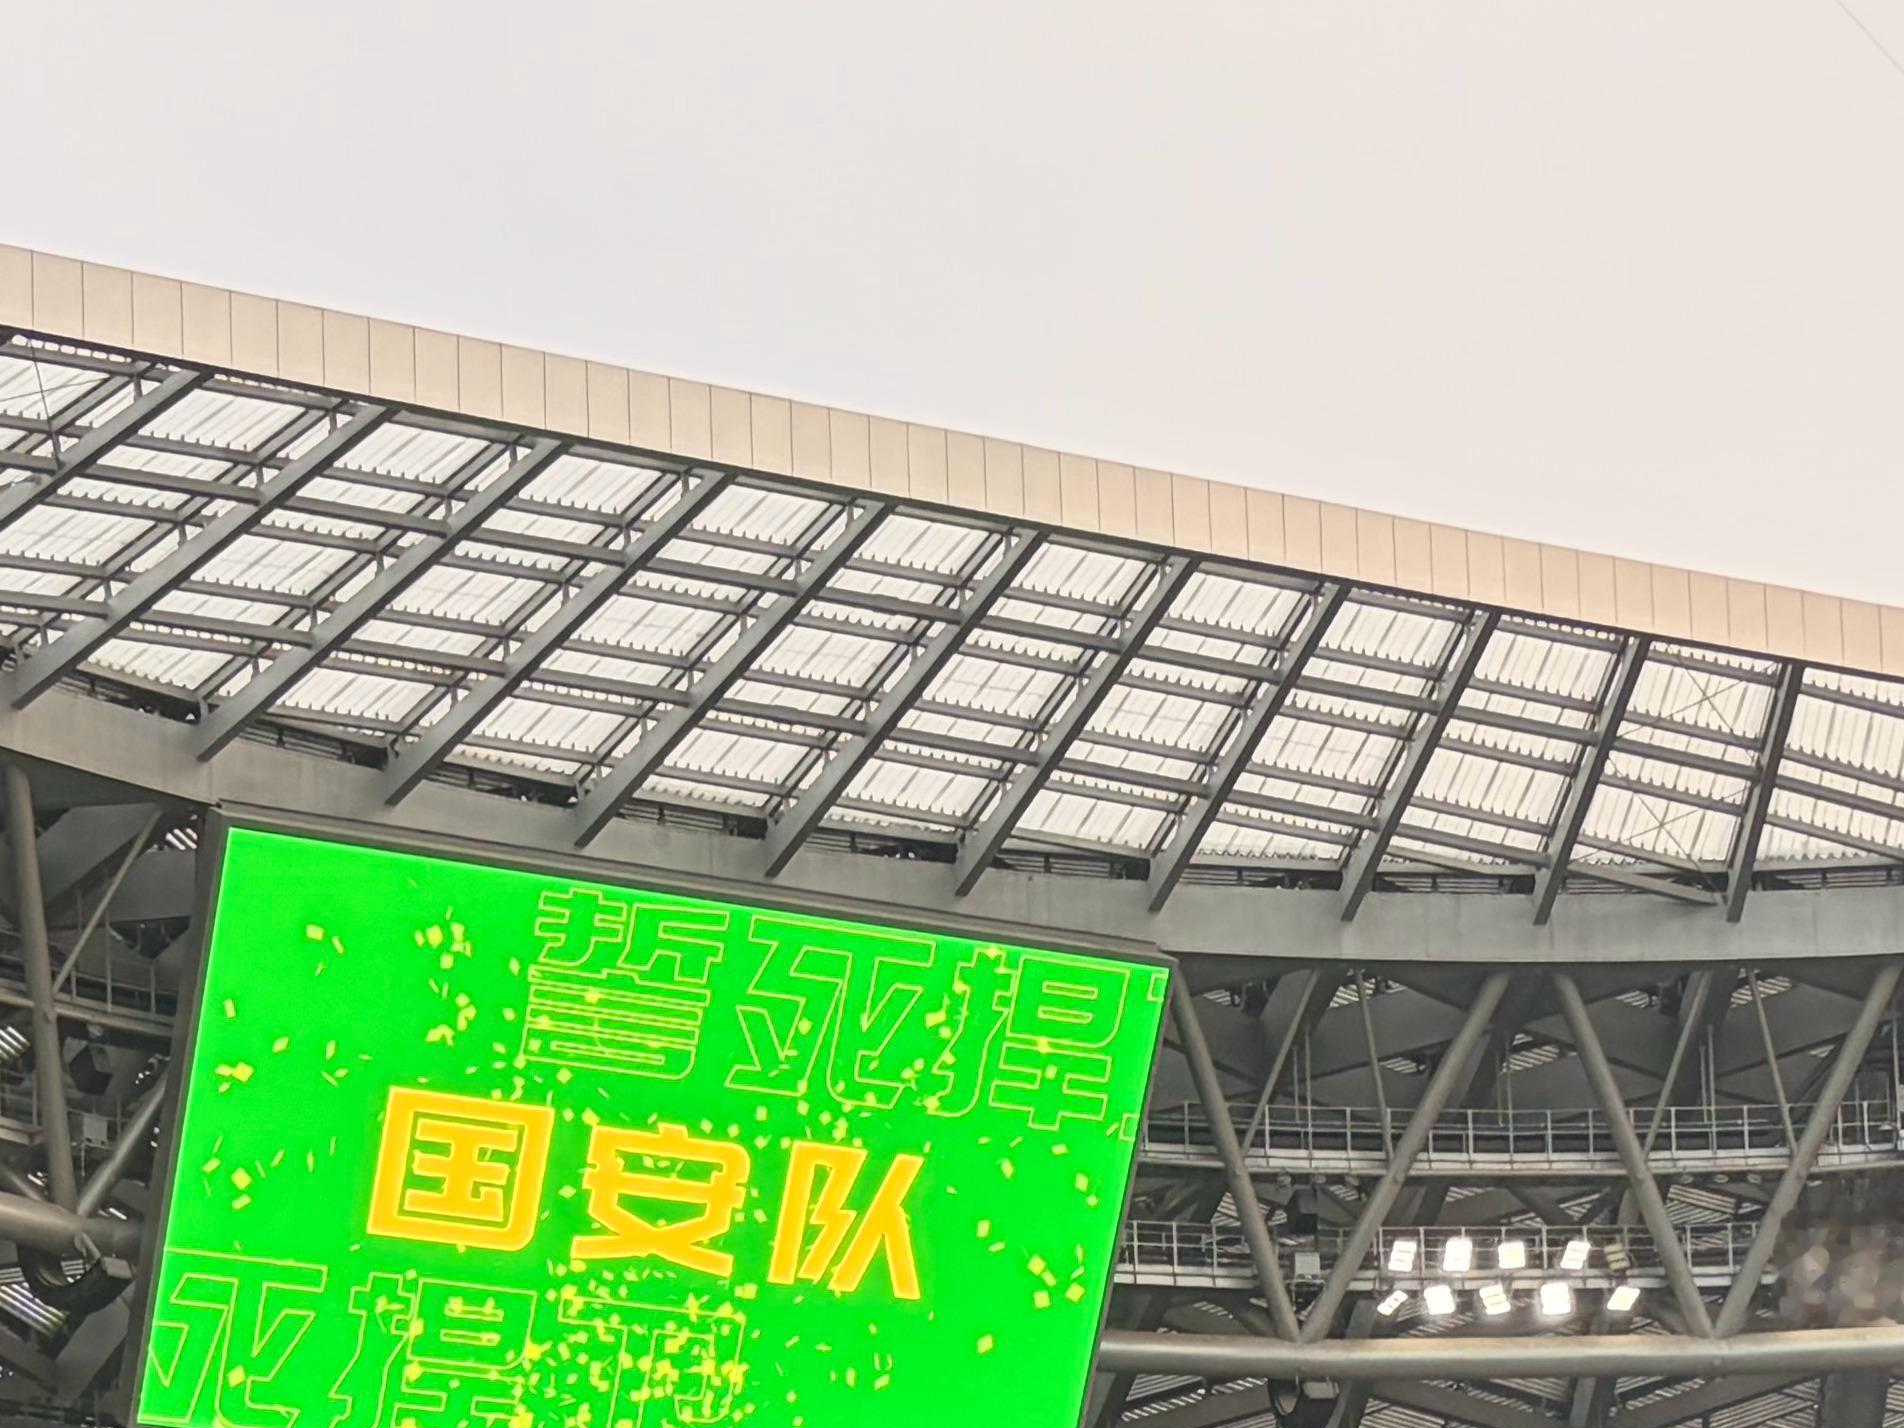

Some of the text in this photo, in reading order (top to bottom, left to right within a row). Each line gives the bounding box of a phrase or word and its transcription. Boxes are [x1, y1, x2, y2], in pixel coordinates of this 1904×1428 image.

[521, 888, 1170, 1141] 誓死捍
[366, 1085, 928, 1300] 国安队
